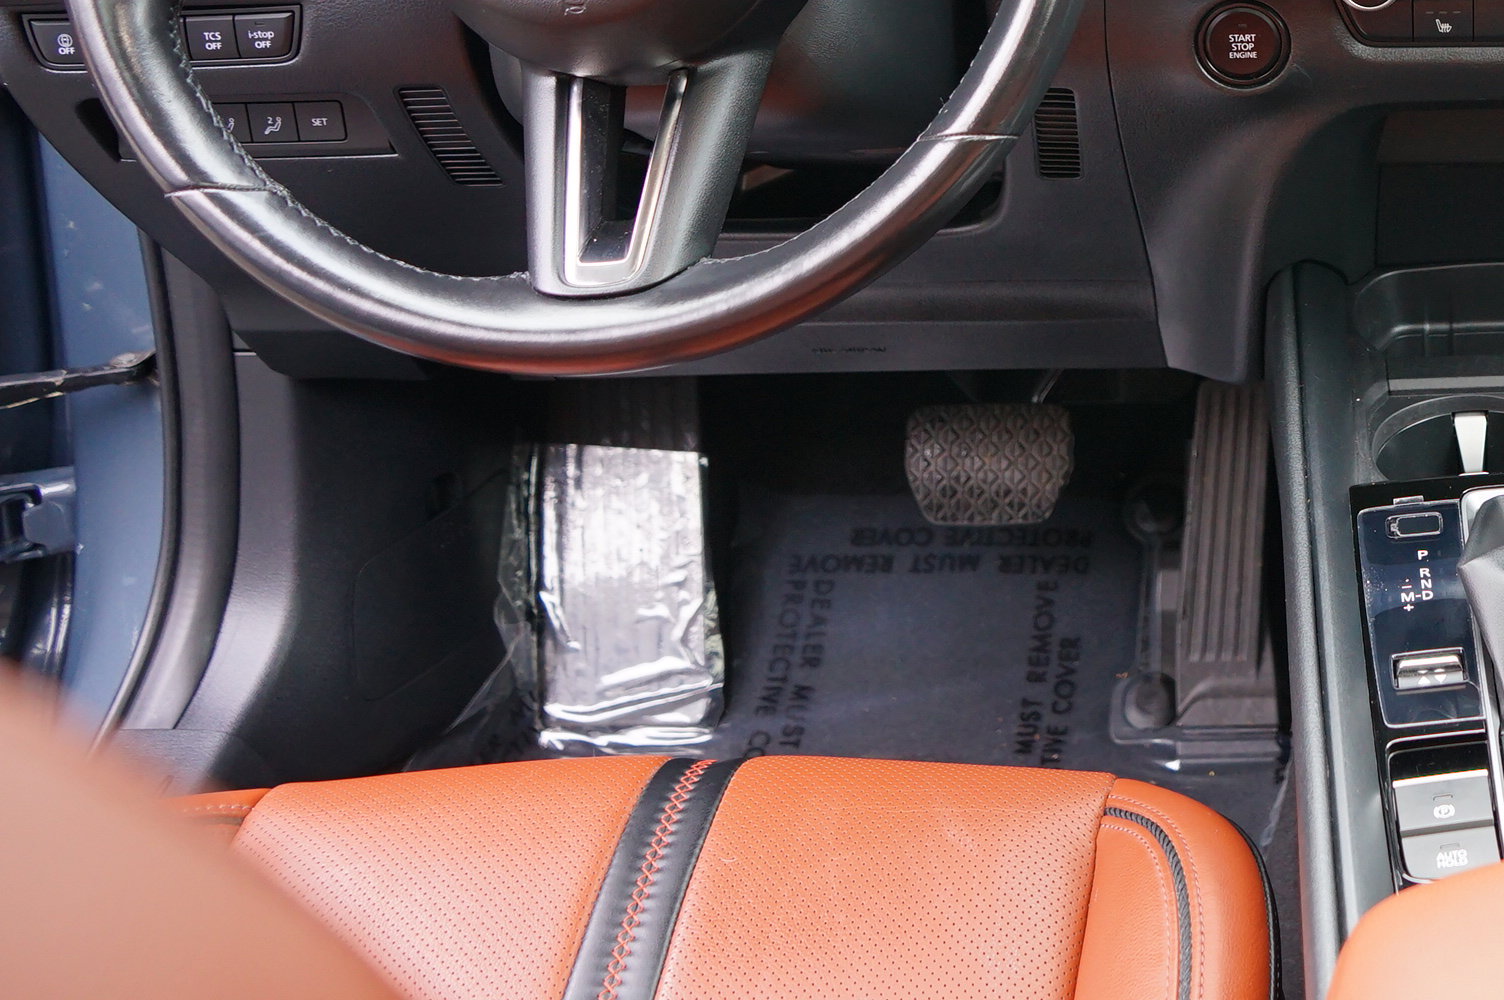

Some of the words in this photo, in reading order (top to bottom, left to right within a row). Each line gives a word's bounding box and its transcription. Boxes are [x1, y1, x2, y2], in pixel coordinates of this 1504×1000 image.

[203, 31, 222, 41] TCS
[248, 29, 275, 42] i-stop
[1228, 34, 1257, 42] START
[205, 41, 222, 51] OFF
[254, 39, 272, 49] OFF
[1231, 43, 1255, 51] STOP
[58, 47, 76, 55] OFF
[1229, 51, 1258, 59] ENGINE
[311, 117, 328, 127] SET
[850, 526, 934, 547] COVER
[1417, 549, 1429, 561] P
[787, 553, 894, 576] REMOVE
[908, 552, 980, 574] MUST
[998, 553, 1090, 575] DEALER
[1419, 567, 1431, 578] R
[1420, 578, 1432, 589] N
[800, 579, 835, 668] DEALER
[1026, 580, 1058, 683] REMOVE
[1051, 637, 1082, 716] COVER
[779, 684, 815, 749] MUST
[1014, 697, 1042, 755] MUST
[1437, 849, 1468, 861] AUTO
[1437, 857, 1469, 870] HOLD
